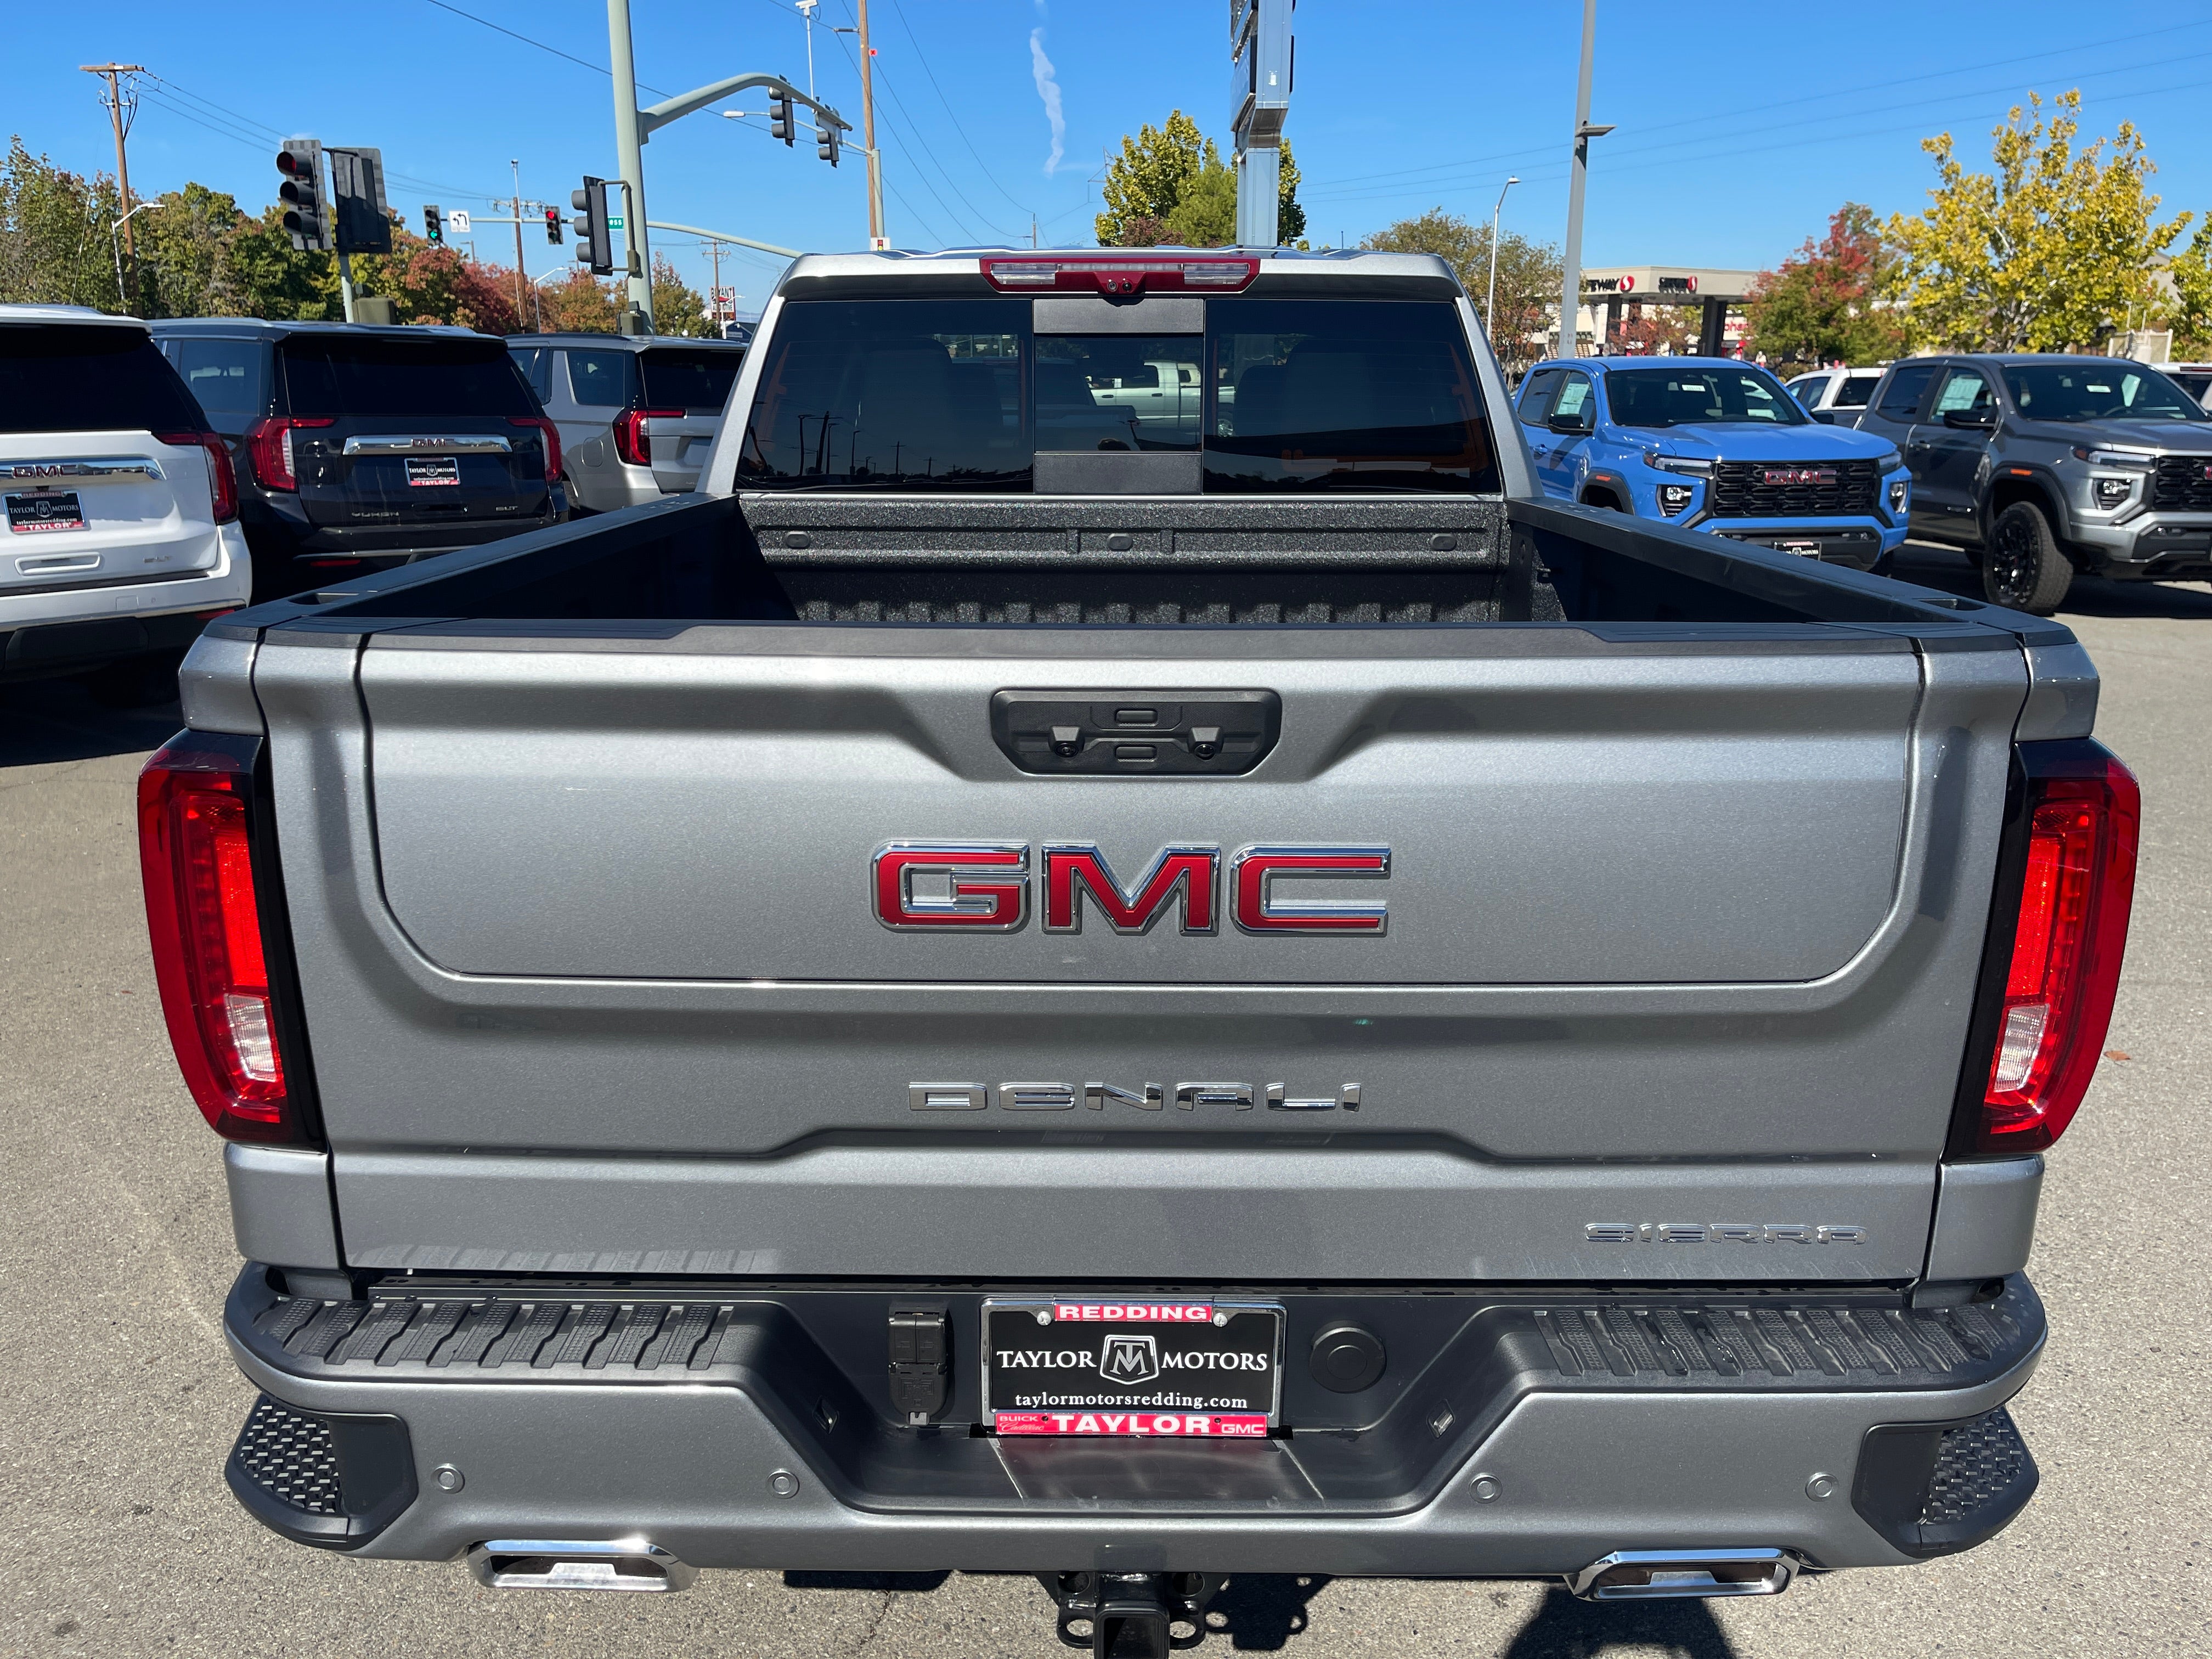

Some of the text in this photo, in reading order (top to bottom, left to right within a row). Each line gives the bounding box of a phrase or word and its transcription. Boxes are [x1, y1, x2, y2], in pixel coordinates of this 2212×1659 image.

[12, 465, 77, 478] GMC
[1764, 470, 1837, 485] GMC
[9, 506, 36, 515] TAYLOR
[52, 504, 79, 512] MOTORS
[29, 522, 70, 531] TAYLOR
[871, 839, 1391, 937] GMC
[909, 1081, 1361, 1111] DENALI
[1585, 1223, 1866, 1244] SIERRA
[1059, 1306, 1207, 1320] REDDING
[996, 1351, 1097, 1369] TAYLOR
[1161, 1351, 1267, 1372] MOTORS
[1015, 1392, 1248, 1409] taylormotorsredding.com
[1000, 1422, 1045, 1432] Cadillac
[1052, 1415, 1210, 1434] TAYLOR
[1221, 1424, 1265, 1434] GMC
